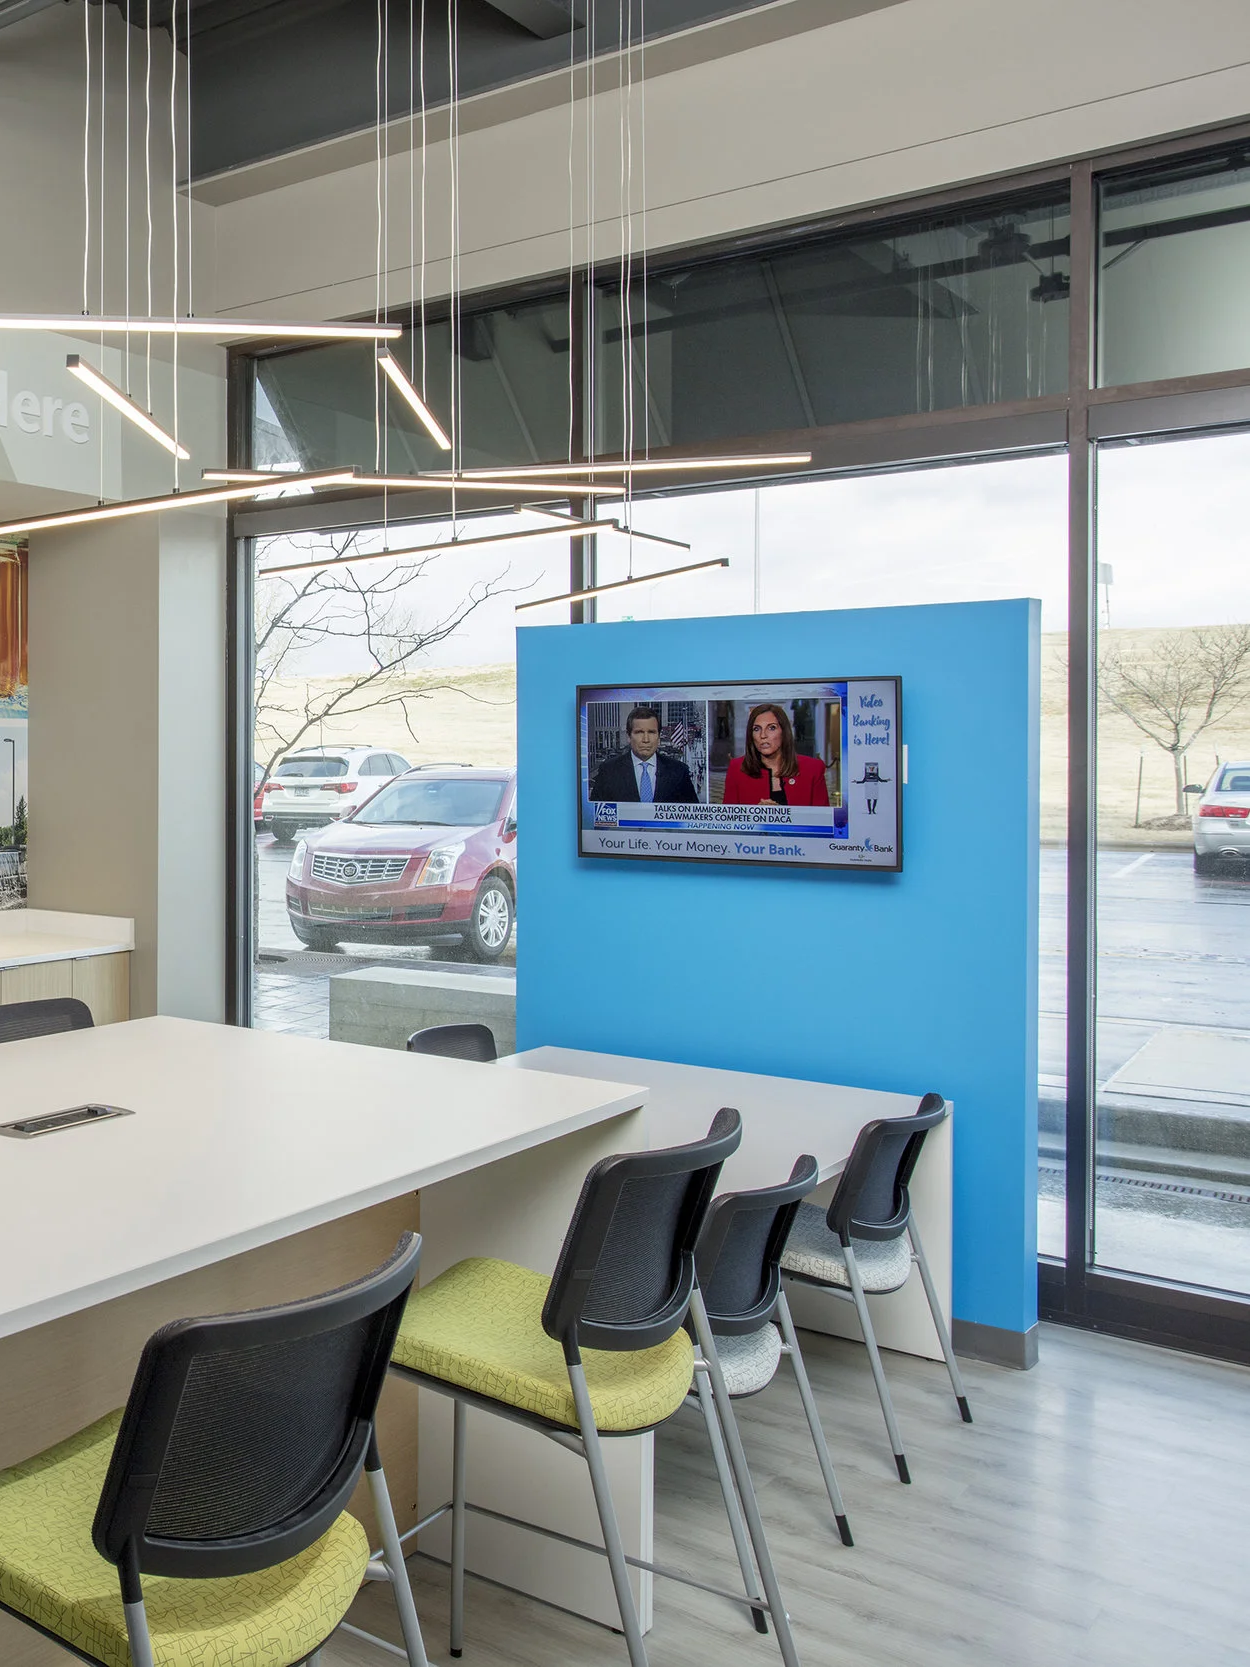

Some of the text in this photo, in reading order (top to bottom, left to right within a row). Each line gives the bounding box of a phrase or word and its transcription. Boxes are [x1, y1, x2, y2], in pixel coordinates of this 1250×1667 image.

[859, 694, 883, 709] Video
[853, 714, 890, 731] Banking
[854, 732, 890, 746] is Here!
[678, 805, 690, 813] ON
[692, 805, 747, 814] IMMIGRATION
[749, 807, 791, 815] CONTINUE
[654, 812, 792, 823] AS LAWMAKERS COMPETE ON DACA
[687, 822, 755, 831] HAPPENING NOW
[598, 837, 806, 857] Your Life. Your Money. Your Bank.
[829, 842, 893, 853] Guaranty Bank
